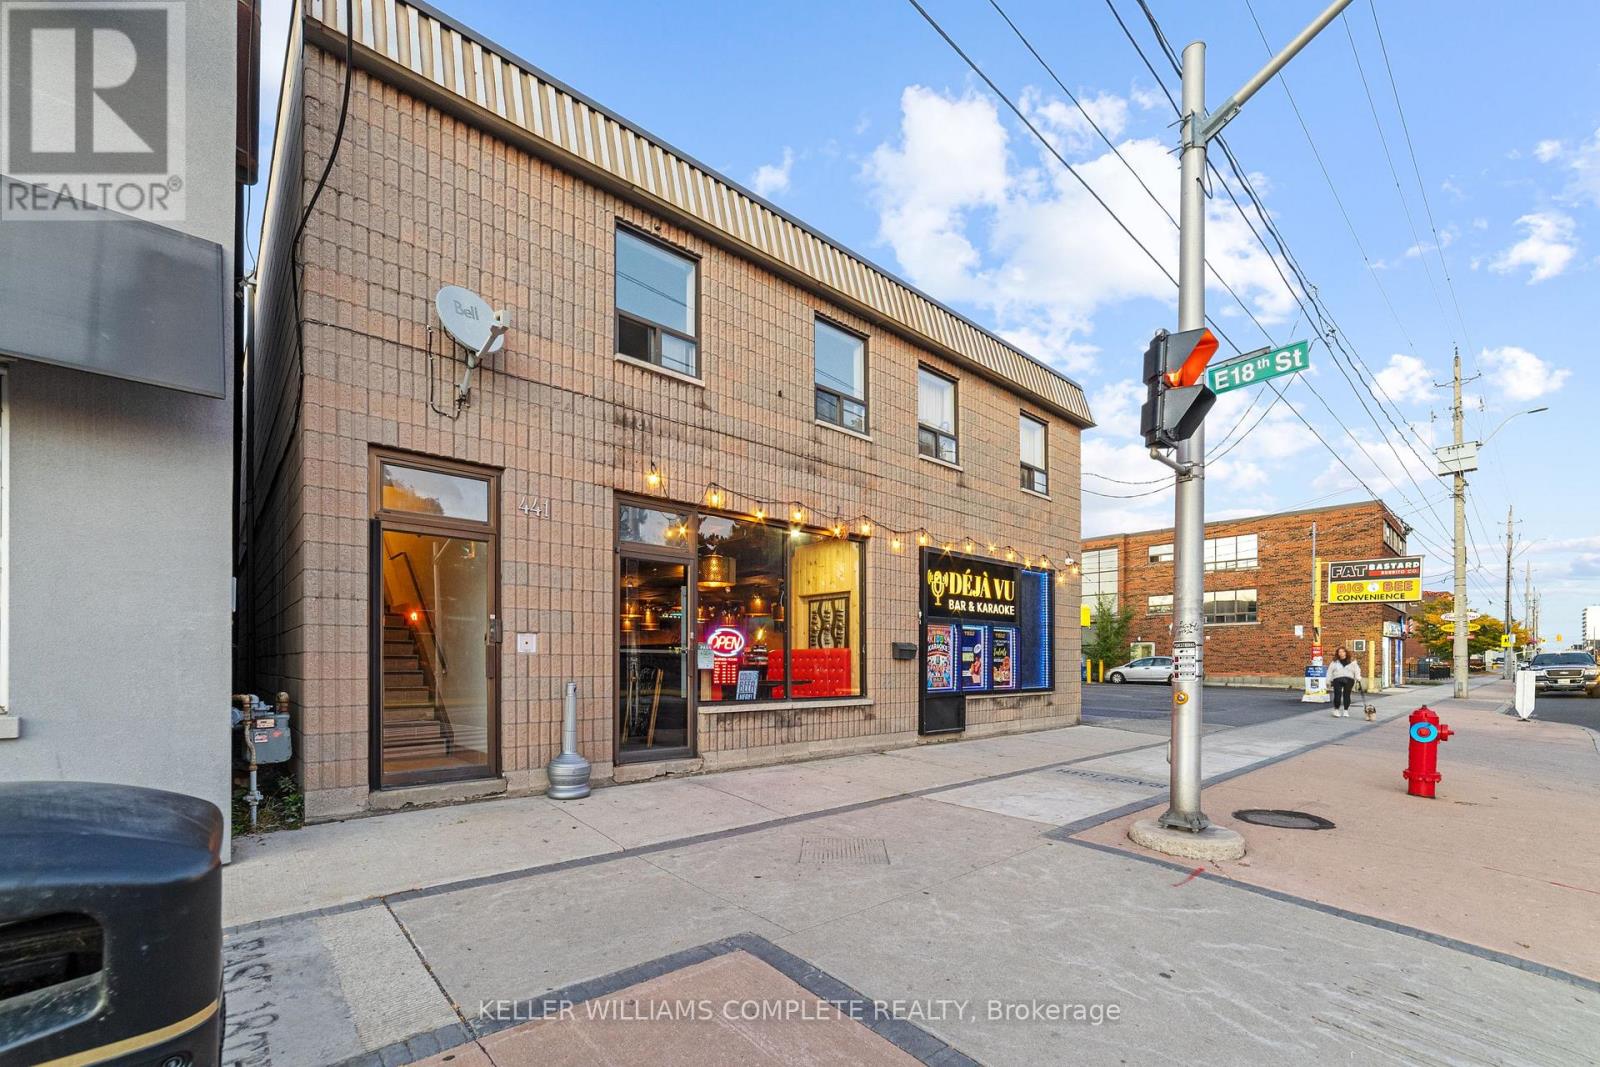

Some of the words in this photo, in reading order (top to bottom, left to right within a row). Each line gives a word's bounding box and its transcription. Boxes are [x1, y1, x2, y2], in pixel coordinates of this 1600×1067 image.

[453, 300, 479, 320] Bell
[1275, 348, 1303, 372] St
[518, 496, 550, 519] 441
[1331, 564, 1367, 578] FAT
[1368, 561, 1419, 570] BASTARD
[948, 568, 991, 599] DÉJÀ
[994, 578, 1015, 601] VU
[1336, 582, 1365, 594] BIG
[1382, 580, 1413, 593] BEE
[1336, 593, 1405, 602] CONVENIENCE
[948, 599, 966, 611] BAR
[969, 601, 975, 612] &
[977, 602, 1015, 616] KARAOKE
[711, 635, 740, 650] OPEN
